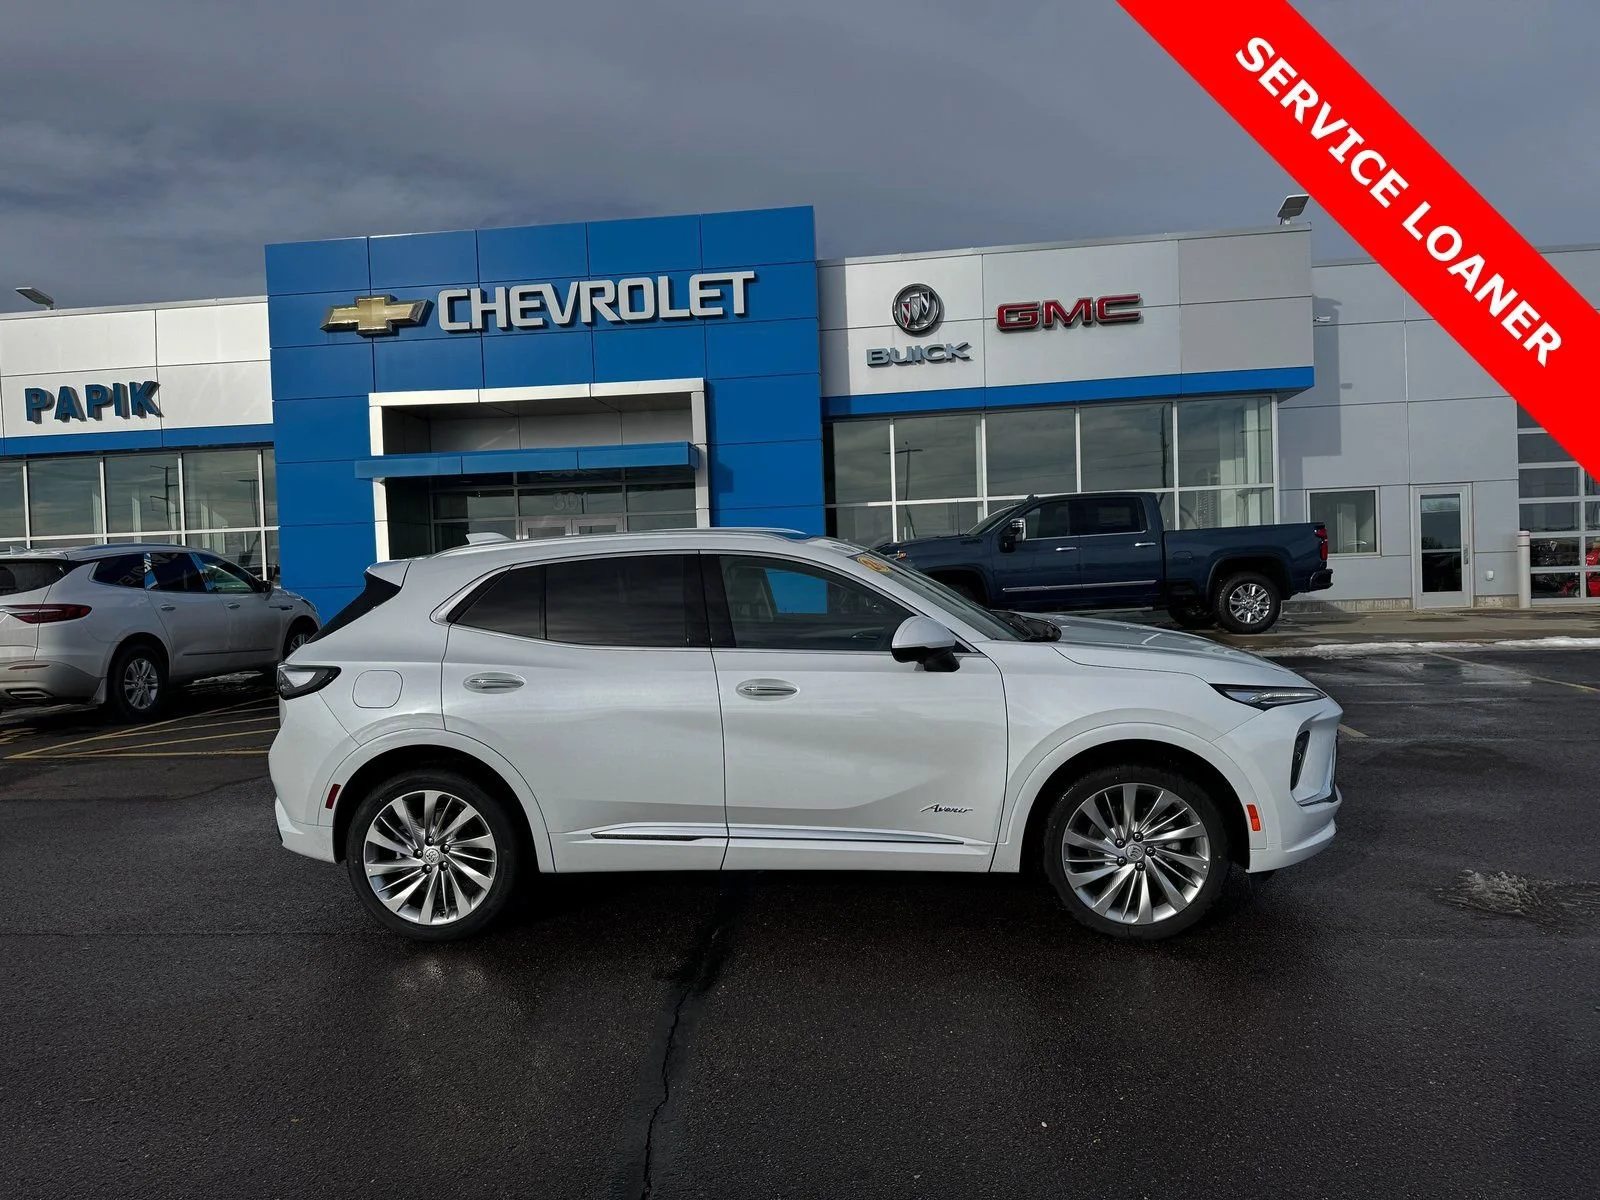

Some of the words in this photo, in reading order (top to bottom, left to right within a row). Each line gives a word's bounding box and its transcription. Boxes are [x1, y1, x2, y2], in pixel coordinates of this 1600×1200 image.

[438, 270, 756, 332] CHEVROLET
[996, 293, 1142, 331] GMC
[866, 342, 971, 367] BUICK
[24, 380, 163, 424] PAPIK
